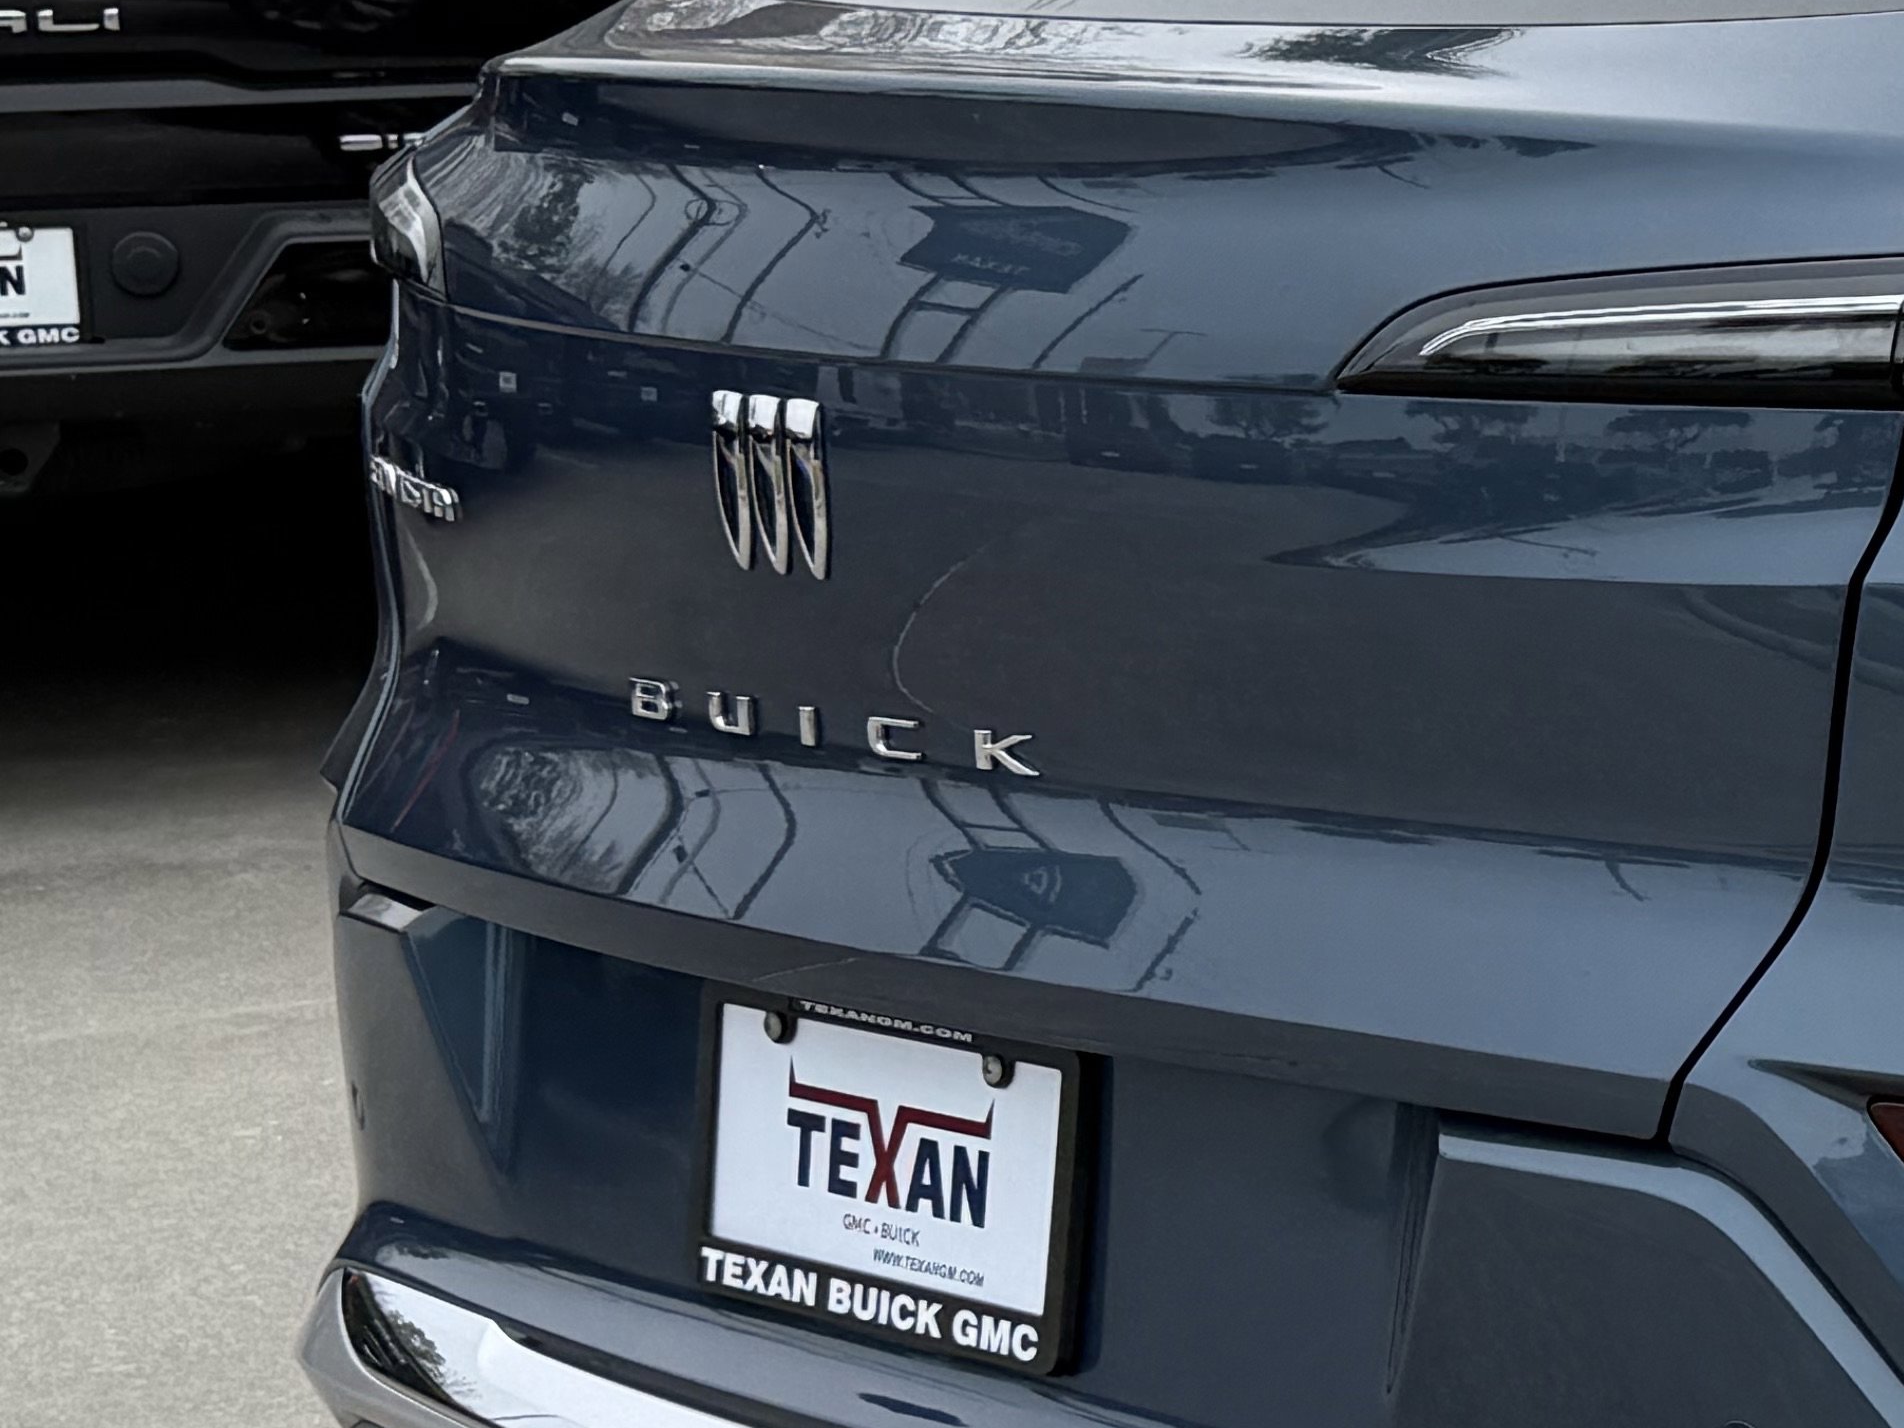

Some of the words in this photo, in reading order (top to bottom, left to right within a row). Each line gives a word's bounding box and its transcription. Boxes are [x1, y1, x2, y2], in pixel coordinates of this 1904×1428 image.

[17, 326, 80, 345] GMC
[630, 677, 1040, 777] BUICK
[787, 1056, 995, 1228] TEXAN
[843, 1213, 872, 1235] GMC
[880, 1222, 921, 1247] BUICK
[701, 1247, 817, 1307] TEXAN
[827, 1279, 942, 1339] BUICK
[952, 1309, 1039, 1362] GMC
